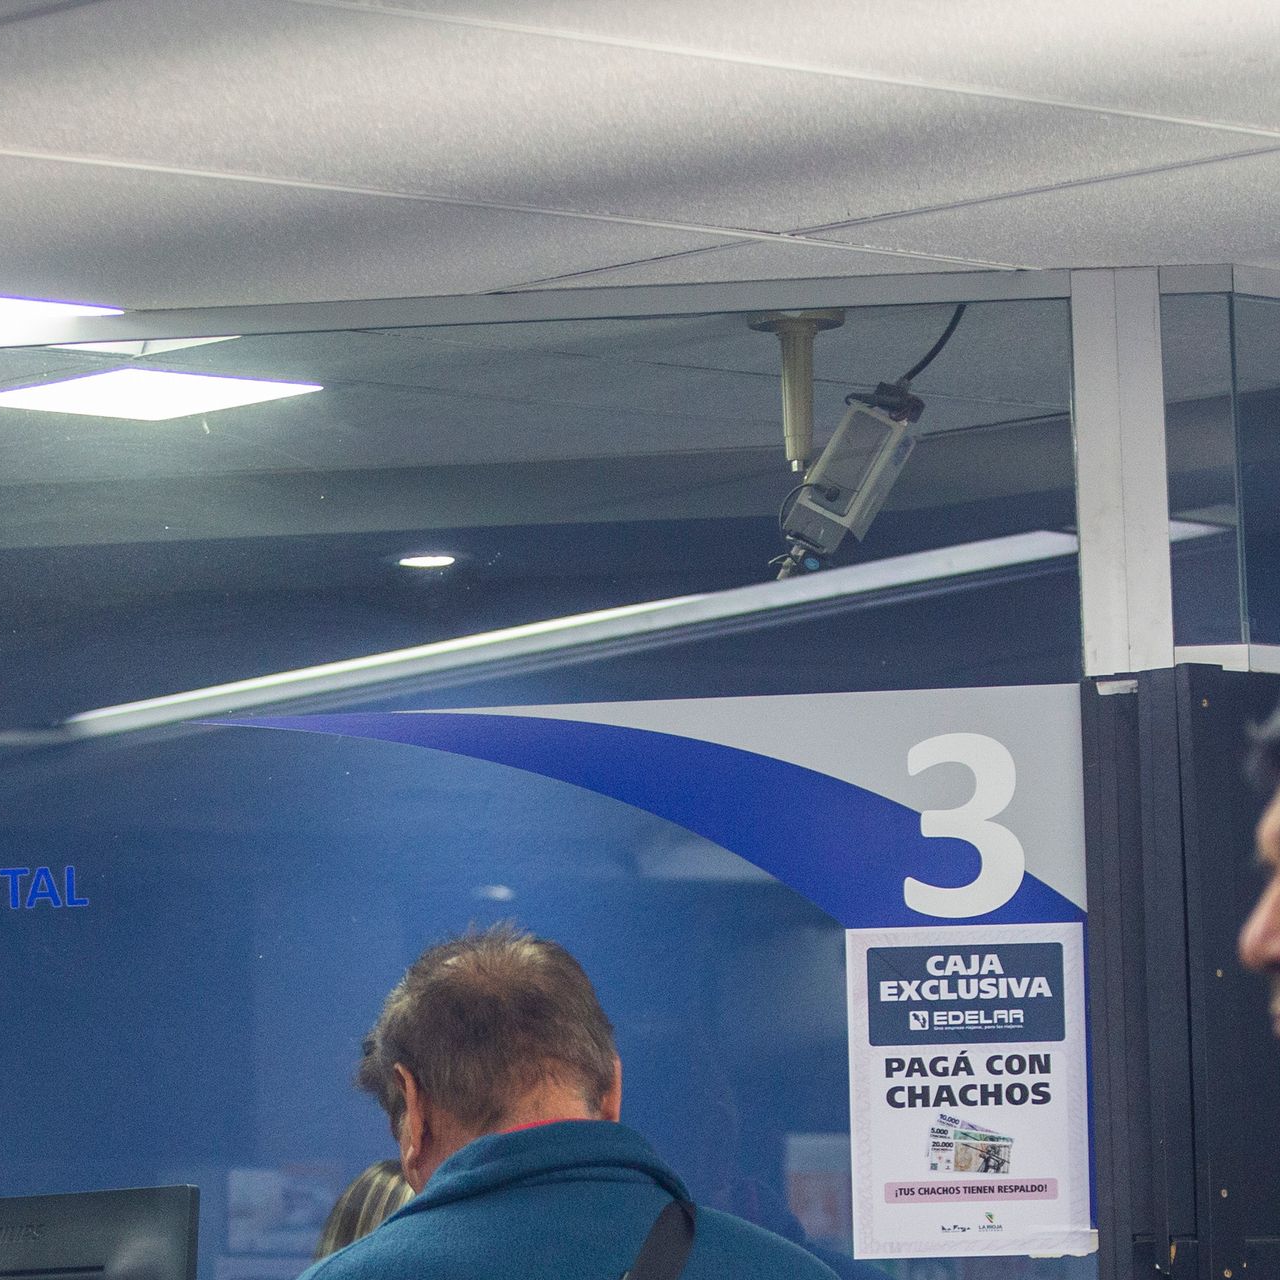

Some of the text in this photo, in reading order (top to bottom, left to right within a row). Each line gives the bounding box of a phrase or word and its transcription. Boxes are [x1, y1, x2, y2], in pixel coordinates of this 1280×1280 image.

[903, 732, 1026, 919] 3
[926, 954, 1004, 976] CAJA
[880, 977, 1053, 1002] EXCLUSIVA
[933, 1009, 1024, 1025] EDELAR
[885, 1050, 1052, 1078] PAGÁ CON
[886, 1082, 1052, 1109] CHACHOS
[895, 1184, 1048, 1197] ¡TUS CHACHOS TIENEN RESPALDO!
